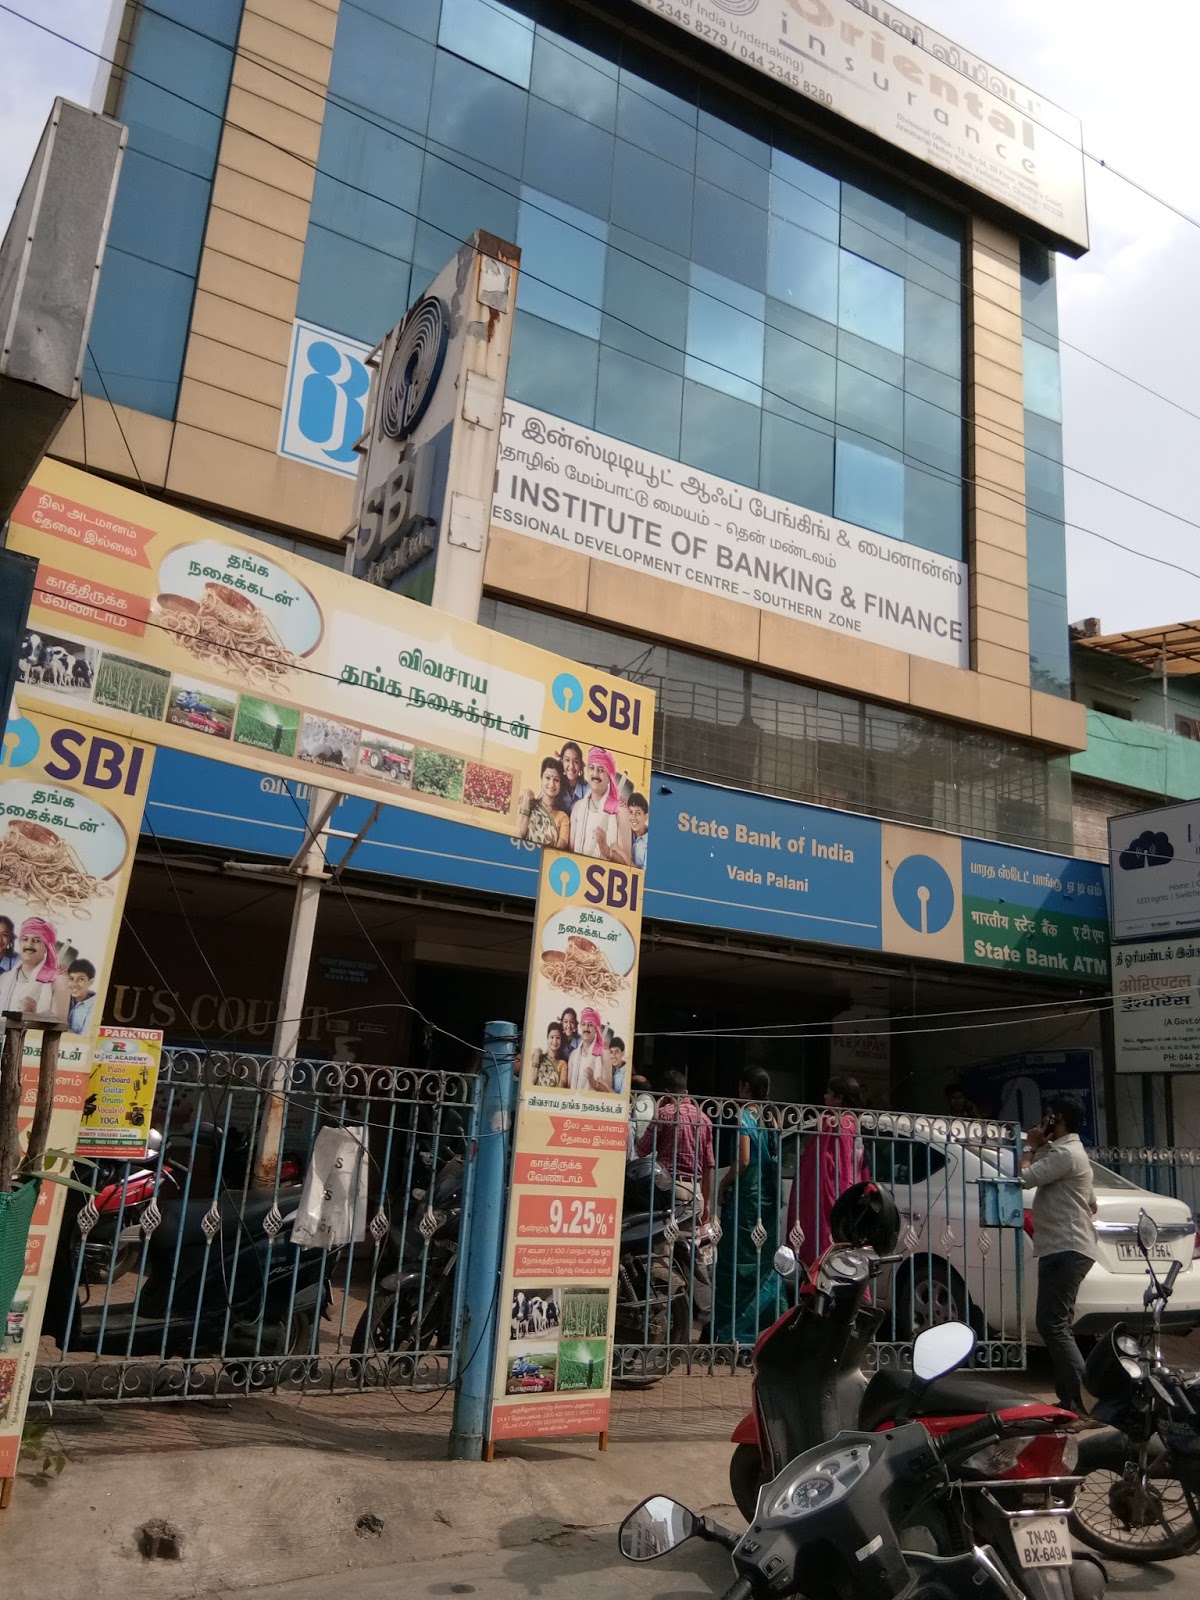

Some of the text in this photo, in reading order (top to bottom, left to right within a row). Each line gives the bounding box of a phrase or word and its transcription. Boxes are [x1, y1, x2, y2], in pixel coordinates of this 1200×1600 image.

[656, 0, 690, 27] 2345
[695, 20, 728, 47] 8279
[740, 45, 764, 68] 044
[769, 61, 800, 87] 2345
[803, 82, 833, 106] 8280
[697, 3, 726, 28] India
[730, 20, 805, 74] Undertaking)
[781, 11, 1036, 174] insurance
[785, 0, 1035, 151] Oriental
[38, 494, 137, 539] நில அடமானம்
[354, 443, 436, 561] SBI
[522, 417, 674, 488] இன்ஸ்டிடியூட்
[681, 477, 742, 511] ஆஃப்
[749, 497, 830, 541] பேங்கிங்
[837, 529, 851, 549] &
[858, 540, 962, 586] பைனான்ஸ்
[565, 464, 649, 508] மேம்பாட்டு
[653, 498, 710, 527] மையம்
[726, 521, 765, 546] தென்
[770, 537, 836, 569] மண்டலம்
[32, 510, 137, 557] தேவை இல்லை
[226, 554, 269, 578] தங்க
[492, 505, 569, 541] ESSIONAL
[575, 530, 681, 576] DEVELOPMENT
[685, 568, 740, 595] CENTRE
[753, 589, 822, 620] SOUTHERN
[828, 612, 862, 632] ZONE
[511, 475, 662, 548] INSTITUTE
[671, 530, 708, 560] OF
[716, 544, 832, 601] BANKING
[840, 586, 856, 610] &
[864, 592, 962, 643] FINANCE
[46, 576, 128, 610] காத்திருக்க
[398, 648, 489, 695] விவசாய
[338, 664, 531, 741] தங்க நகைக்கடன்
[586, 684, 641, 736] SBI
[44, 729, 144, 796] SBI
[31, 790, 75, 808] தங்க
[677, 812, 854, 864] State Bank of India
[584, 864, 639, 911] SBI
[726, 864, 809, 892] Vada Palani
[971, 862, 995, 879] பாரத
[998, 864, 1030, 884] ஸ்டேட்
[579, 911, 603, 925] தங்க
[971, 910, 1009, 930] भारतीय
[1014, 915, 1036, 933] स्टेट
[1041, 918, 1058, 937] बैंक
[974, 939, 1107, 975] State Bank ATM
[104, 1029, 158, 1040] PARKING
[190, 994, 328, 1041] COUT
[100, 1075, 131, 1085] Keyboard
[107, 1065, 126, 1074] Piano
[101, 1096, 124, 1104] Drums
[103, 1086, 125, 1094] Guitar
[528, 1096, 622, 1114] விவசாய தங்க நகைக்கடன்
[97, 1106, 118, 1114] Vocals
[99, 1116, 119, 1125] YOGA
[563, 1119, 625, 1134] நில அடமானம்
[119, 1131, 137, 1139] London
[560, 1133, 625, 1147] தேவை இல்லை
[527, 1171, 583, 1184] வேண்டாம்
[530, 1157, 582, 1171] காத்திருக்க
